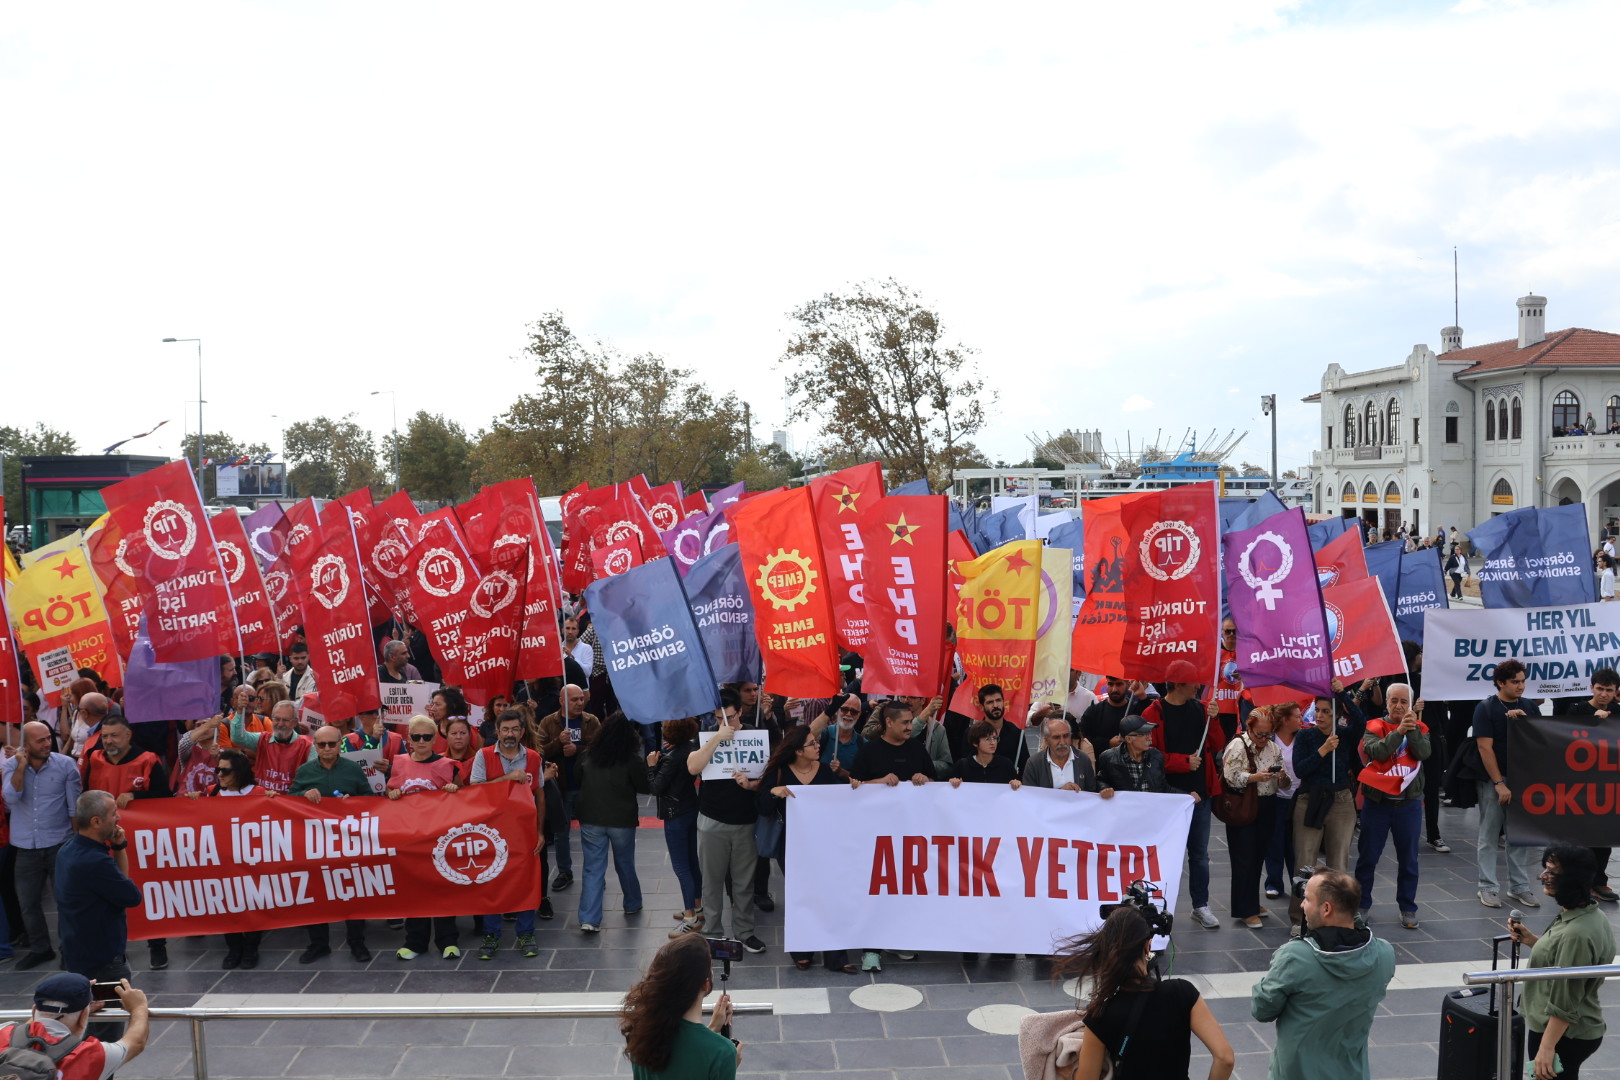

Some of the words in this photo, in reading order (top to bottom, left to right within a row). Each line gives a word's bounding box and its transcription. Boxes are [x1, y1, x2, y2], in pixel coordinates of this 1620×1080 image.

[1527, 611, 1564, 631] HER
[1565, 608, 1596, 628] YIL
[1454, 638, 1488, 658] BU
[1494, 630, 1568, 658] EYLEMİ
[1466, 661, 1579, 682] ZOUNDA
[384, 696, 399, 705] LÜTUF
[737, 737, 764, 747] TEKİN
[1565, 730, 1620, 772] ÖL
[1522, 783, 1620, 816] OKU
[134, 825, 220, 869] PARA
[231, 815, 292, 866] İÇİN
[305, 811, 397, 860] DEĞİL.
[437, 831, 458, 852] TÜRKİYE
[478, 827, 501, 844] PARTİSİ
[452, 837, 489, 858] TİP
[868, 835, 1002, 897] ARTIK
[1016, 837, 1163, 901] YETER!
[142, 871, 315, 921] ONURUMUZ
[322, 863, 396, 902] İÇİN!
